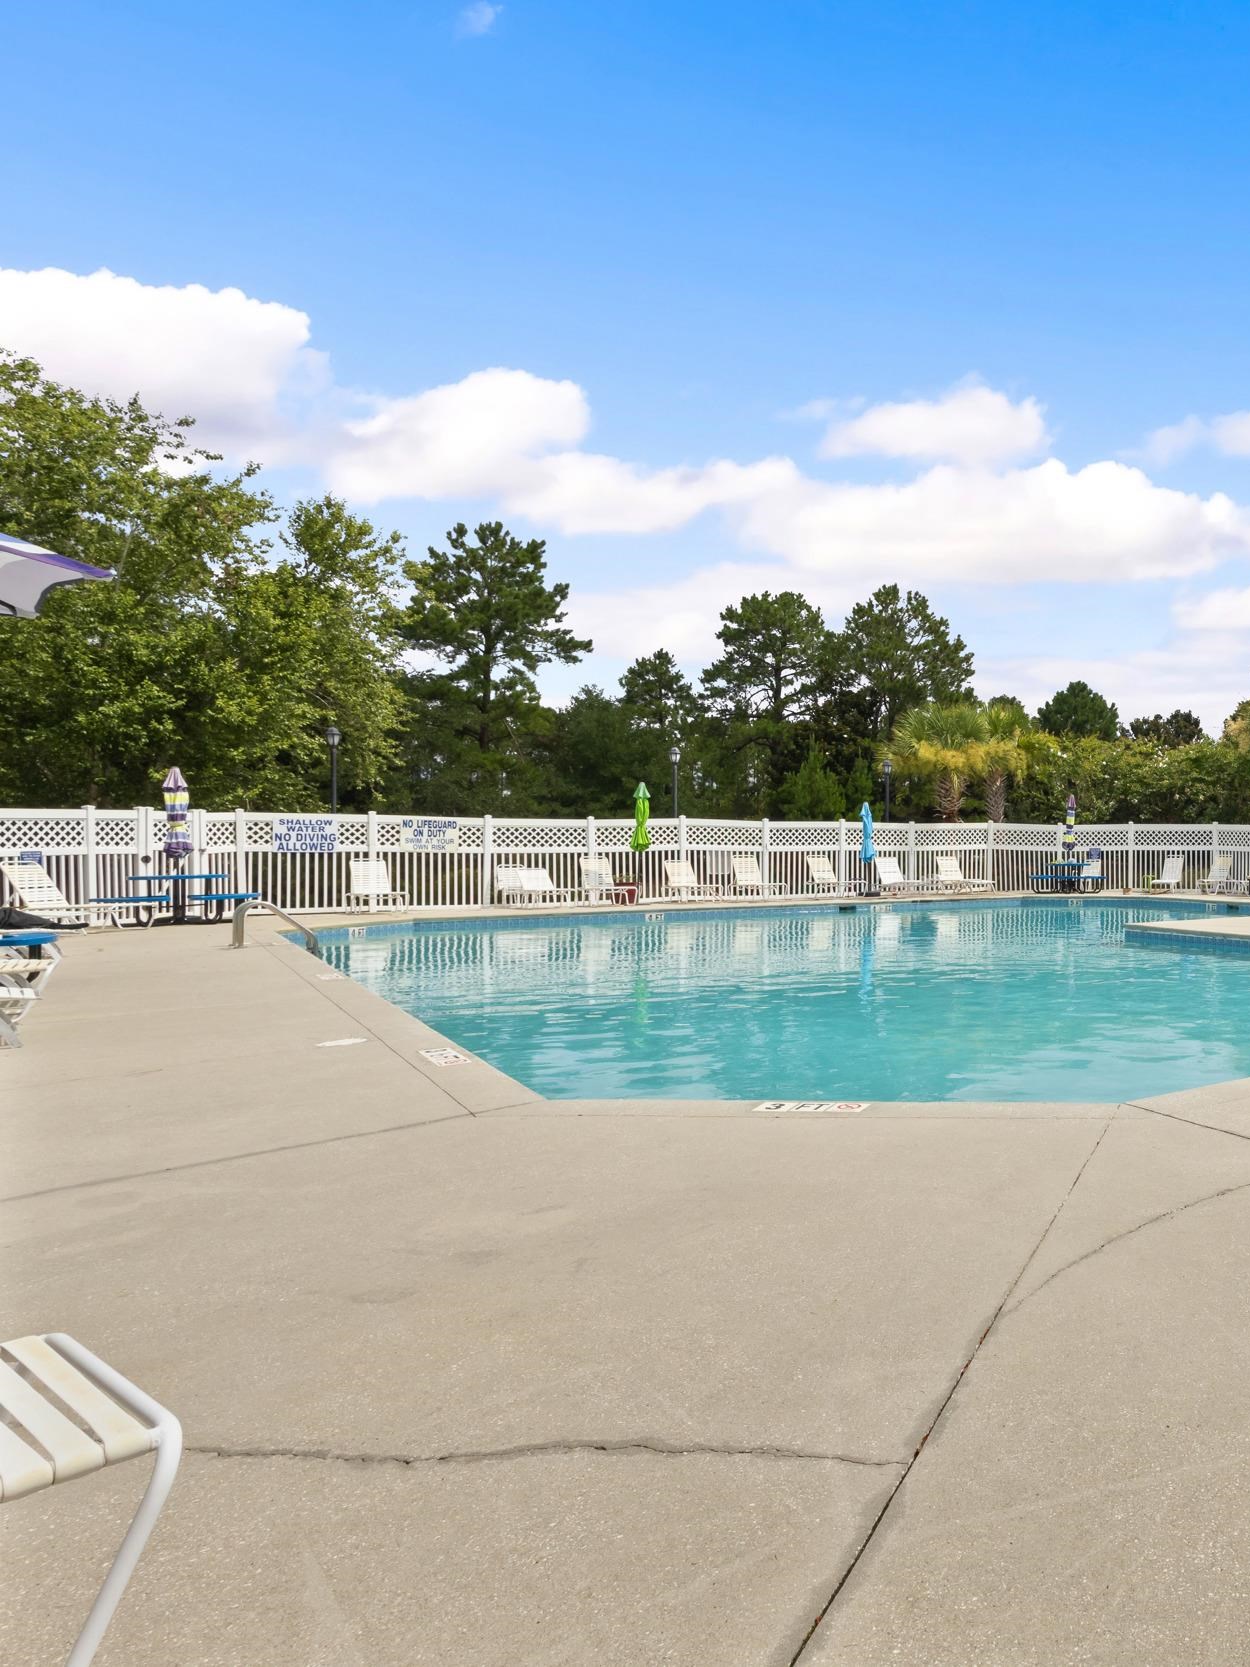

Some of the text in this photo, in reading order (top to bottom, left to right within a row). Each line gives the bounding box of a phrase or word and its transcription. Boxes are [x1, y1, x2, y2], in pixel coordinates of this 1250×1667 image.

[402, 819, 457, 829] NO LIFEGUARD
[275, 832, 336, 842] NO DIVING
[413, 829, 447, 838] ON DUTY
[277, 842, 334, 852] ALLOWED
[795, 1103, 830, 1111] FT
